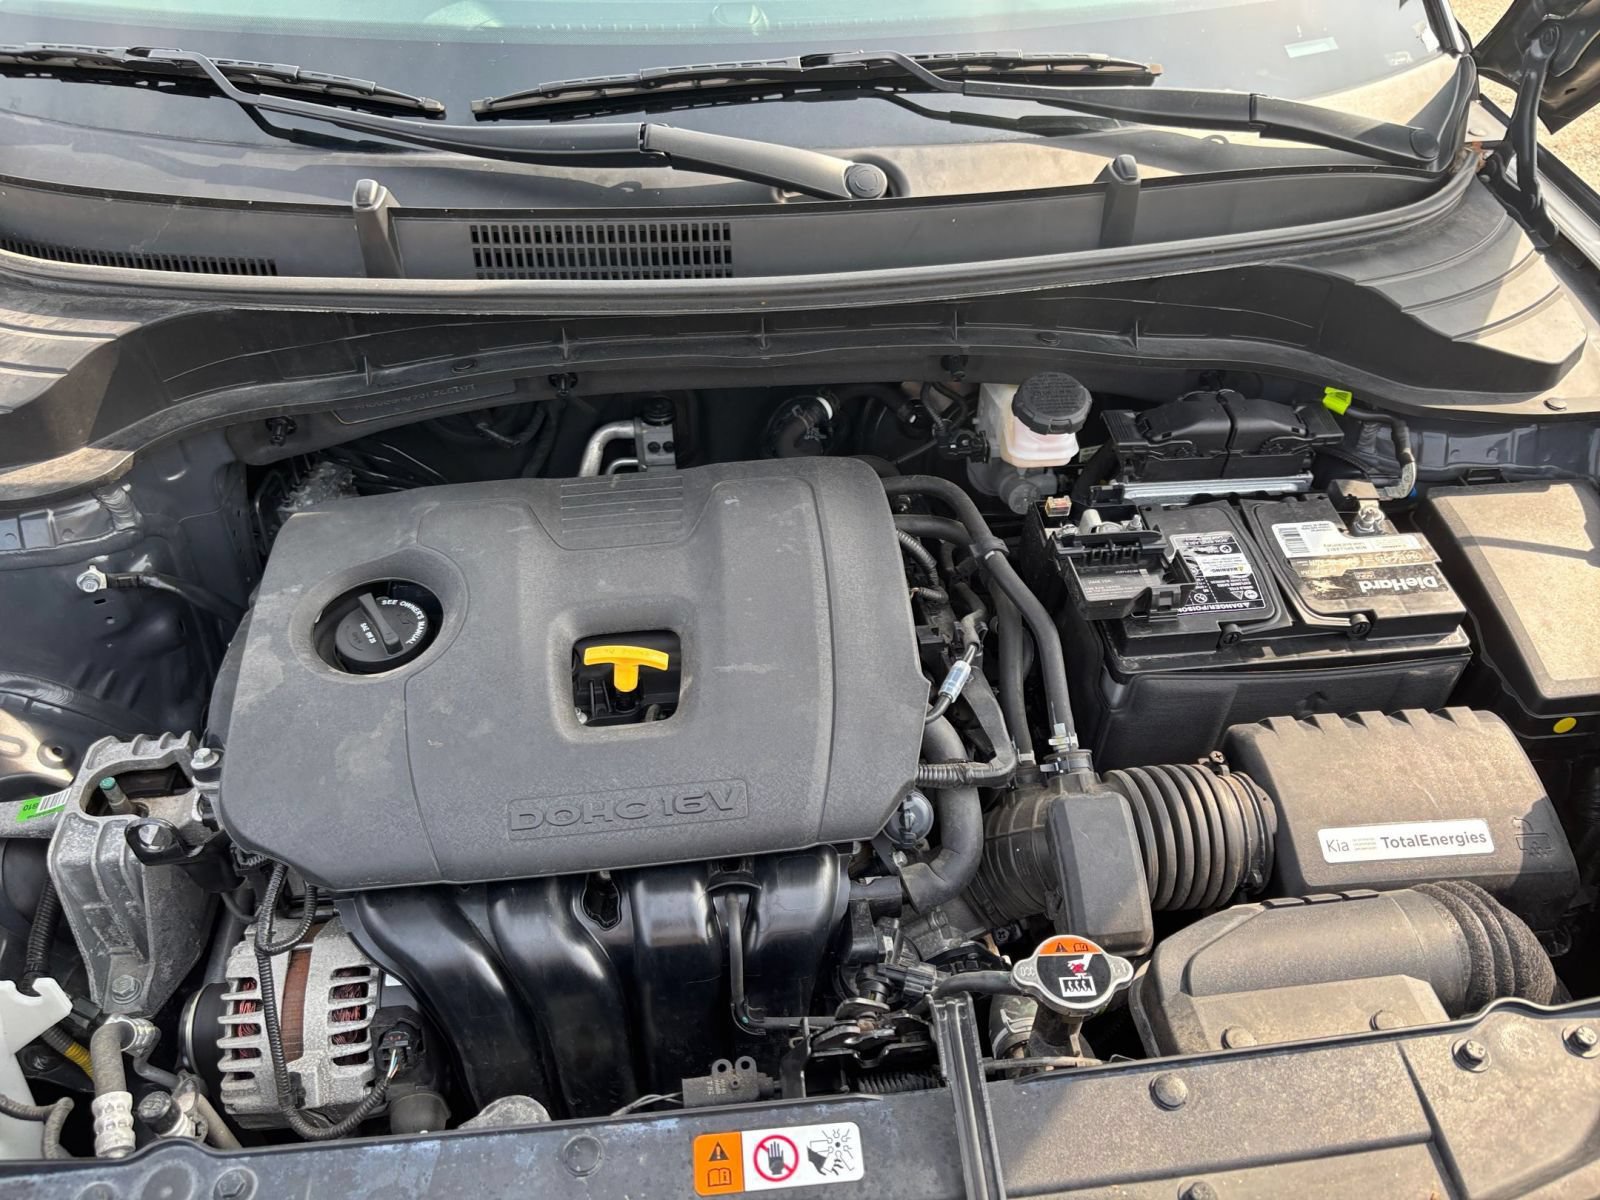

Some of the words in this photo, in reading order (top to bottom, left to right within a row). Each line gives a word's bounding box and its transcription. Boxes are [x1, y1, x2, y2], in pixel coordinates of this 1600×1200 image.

[1358, 576, 1439, 593] DieHard
[399, 600, 425, 620] OWNER'S
[405, 621, 426, 645] MANUAL
[510, 800, 650, 832] DOHC
[661, 787, 742, 817] 16V
[1325, 839, 1350, 853] Kia
[1380, 831, 1487, 850] TotalEnergies
